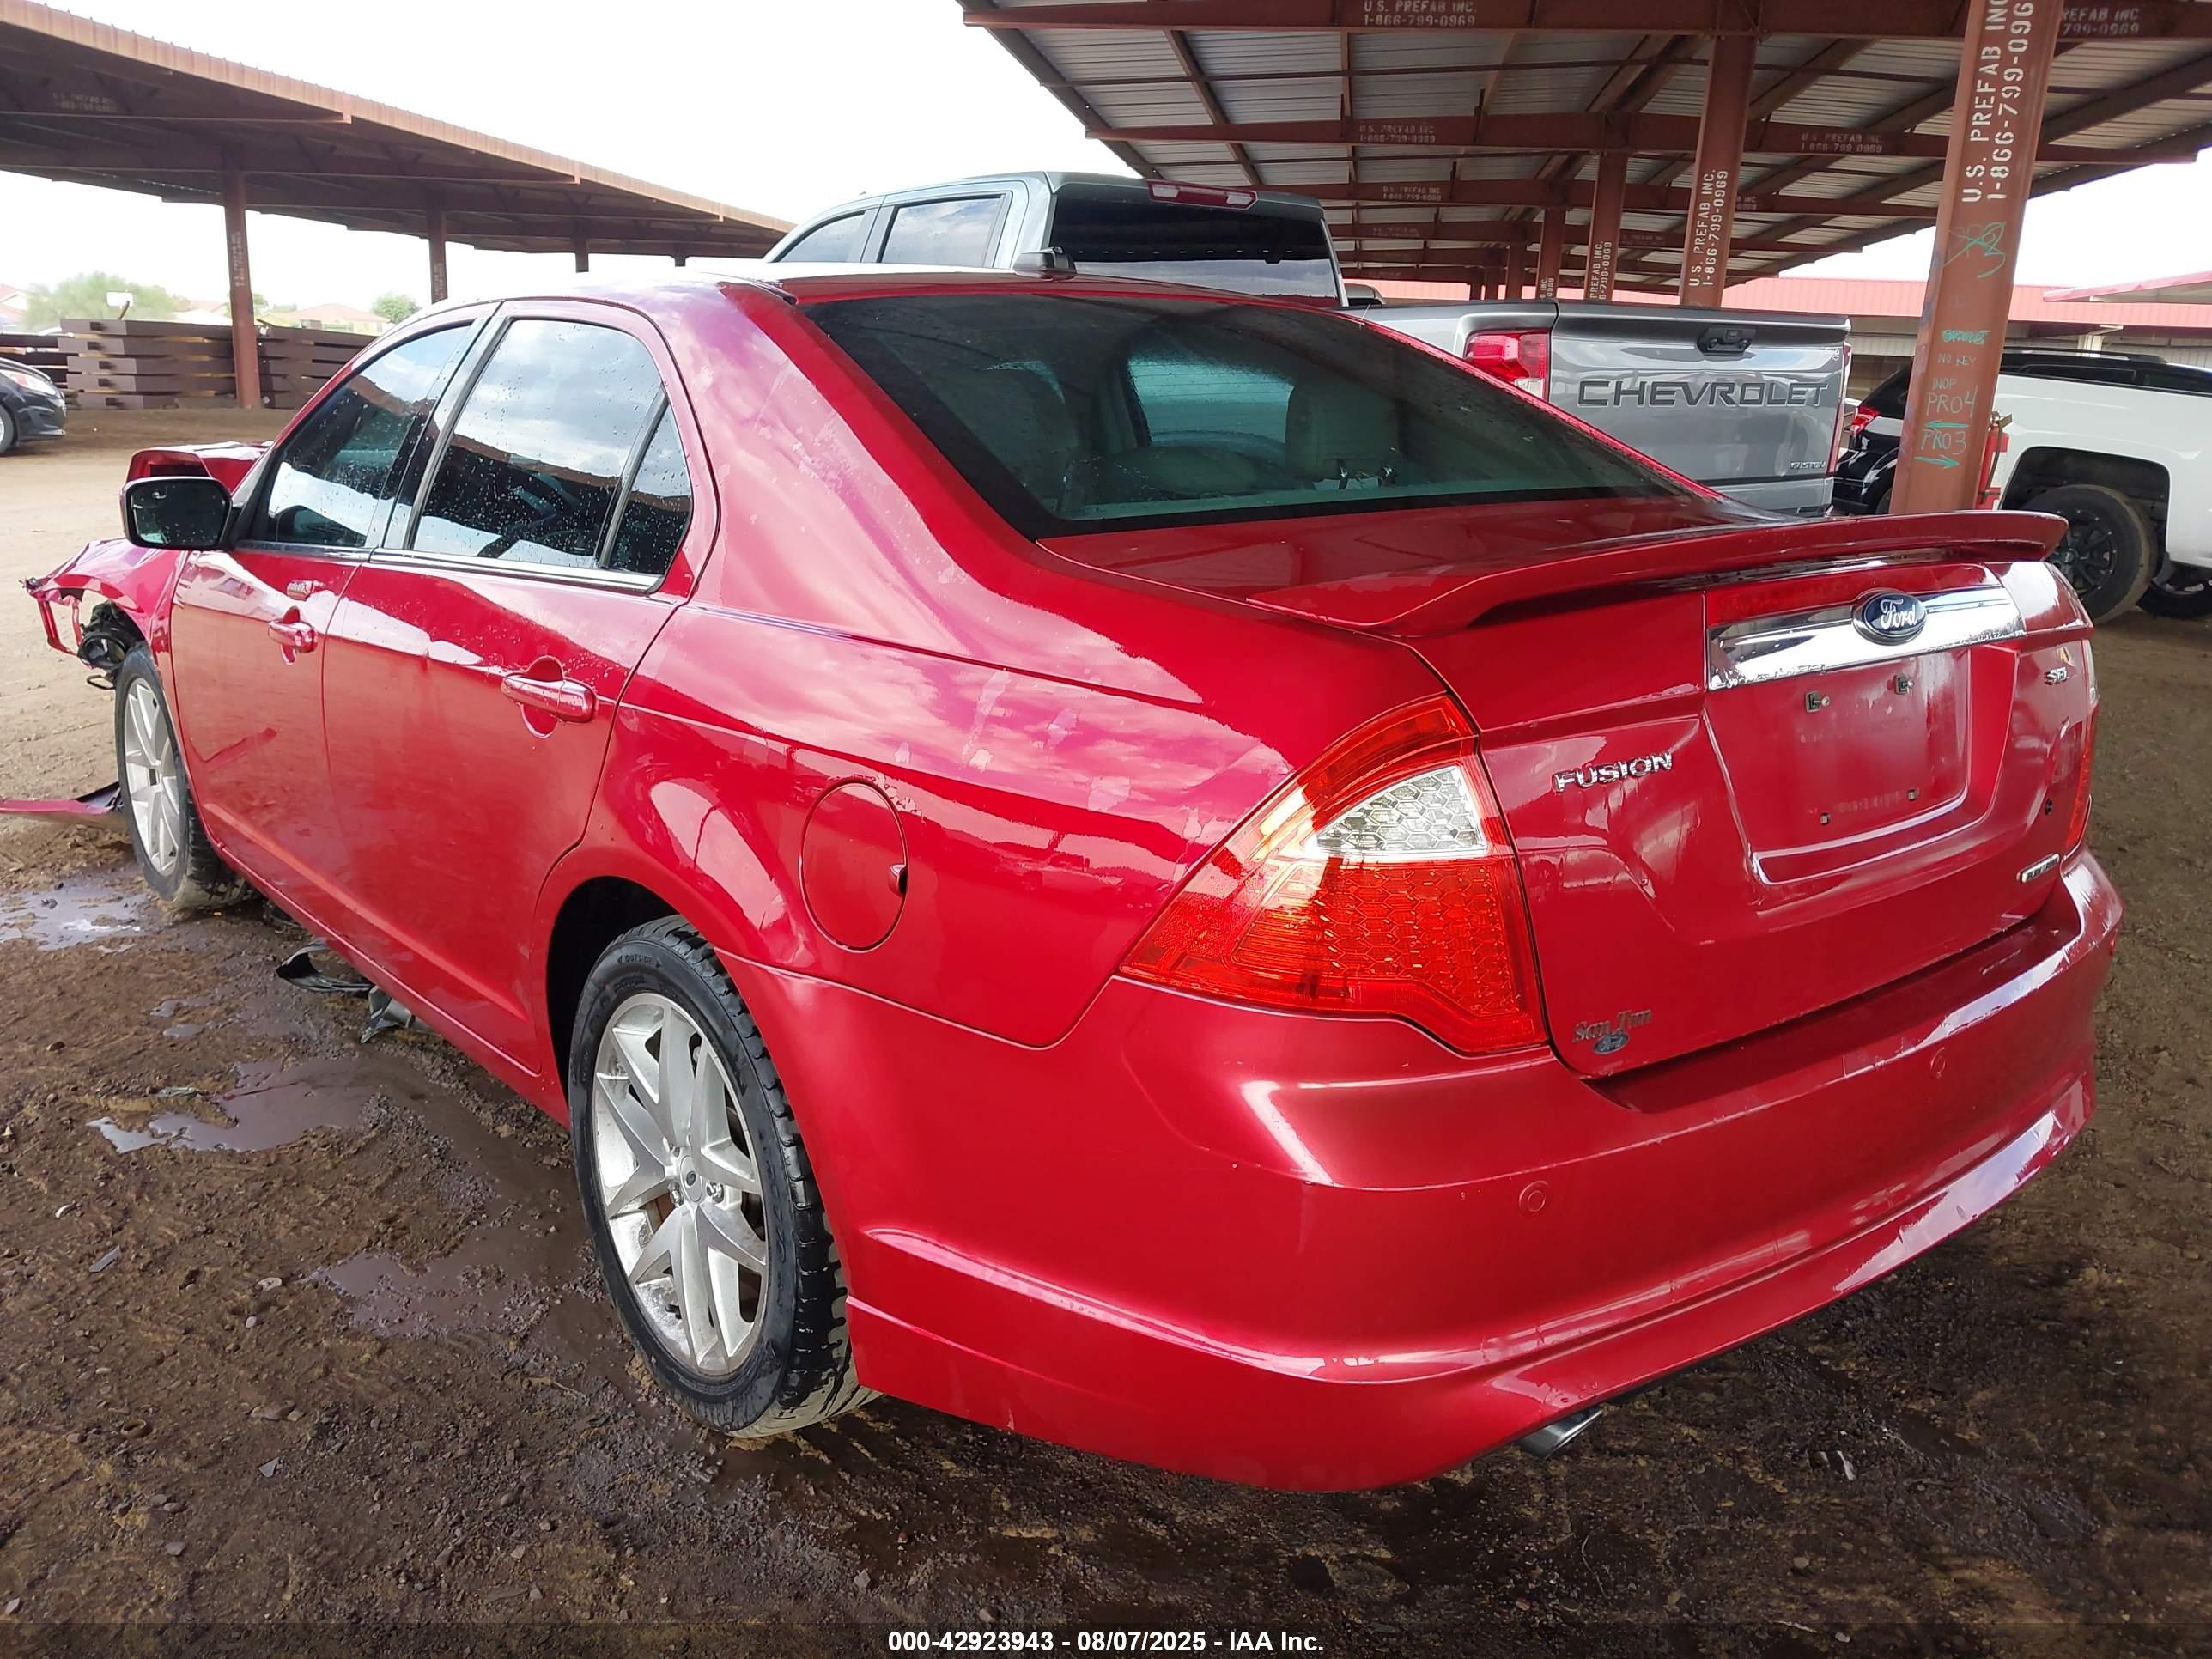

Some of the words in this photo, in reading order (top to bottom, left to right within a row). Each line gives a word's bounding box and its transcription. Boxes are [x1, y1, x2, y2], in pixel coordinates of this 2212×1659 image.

[1364, 14, 1476, 27] 1-866-799-0969
[1395, 0, 1447, 13] PREFAB
[2063, 7, 2109, 21] REFAB
[1969, 45, 2002, 143] PREFAB
[1701, 169, 1717, 195] INC.
[1961, 155, 1988, 203] U.S.
[1692, 202, 1711, 254] PREFAB
[1702, 170, 1729, 286] 1-866-799-0969
[1688, 261, 1704, 287] U.S.
[1577, 380, 1828, 407] CHEVROLET
[1925, 384, 1978, 419] PRO4
[1880, 599, 1919, 630] Ford
[1552, 751, 1673, 793] FUSION
